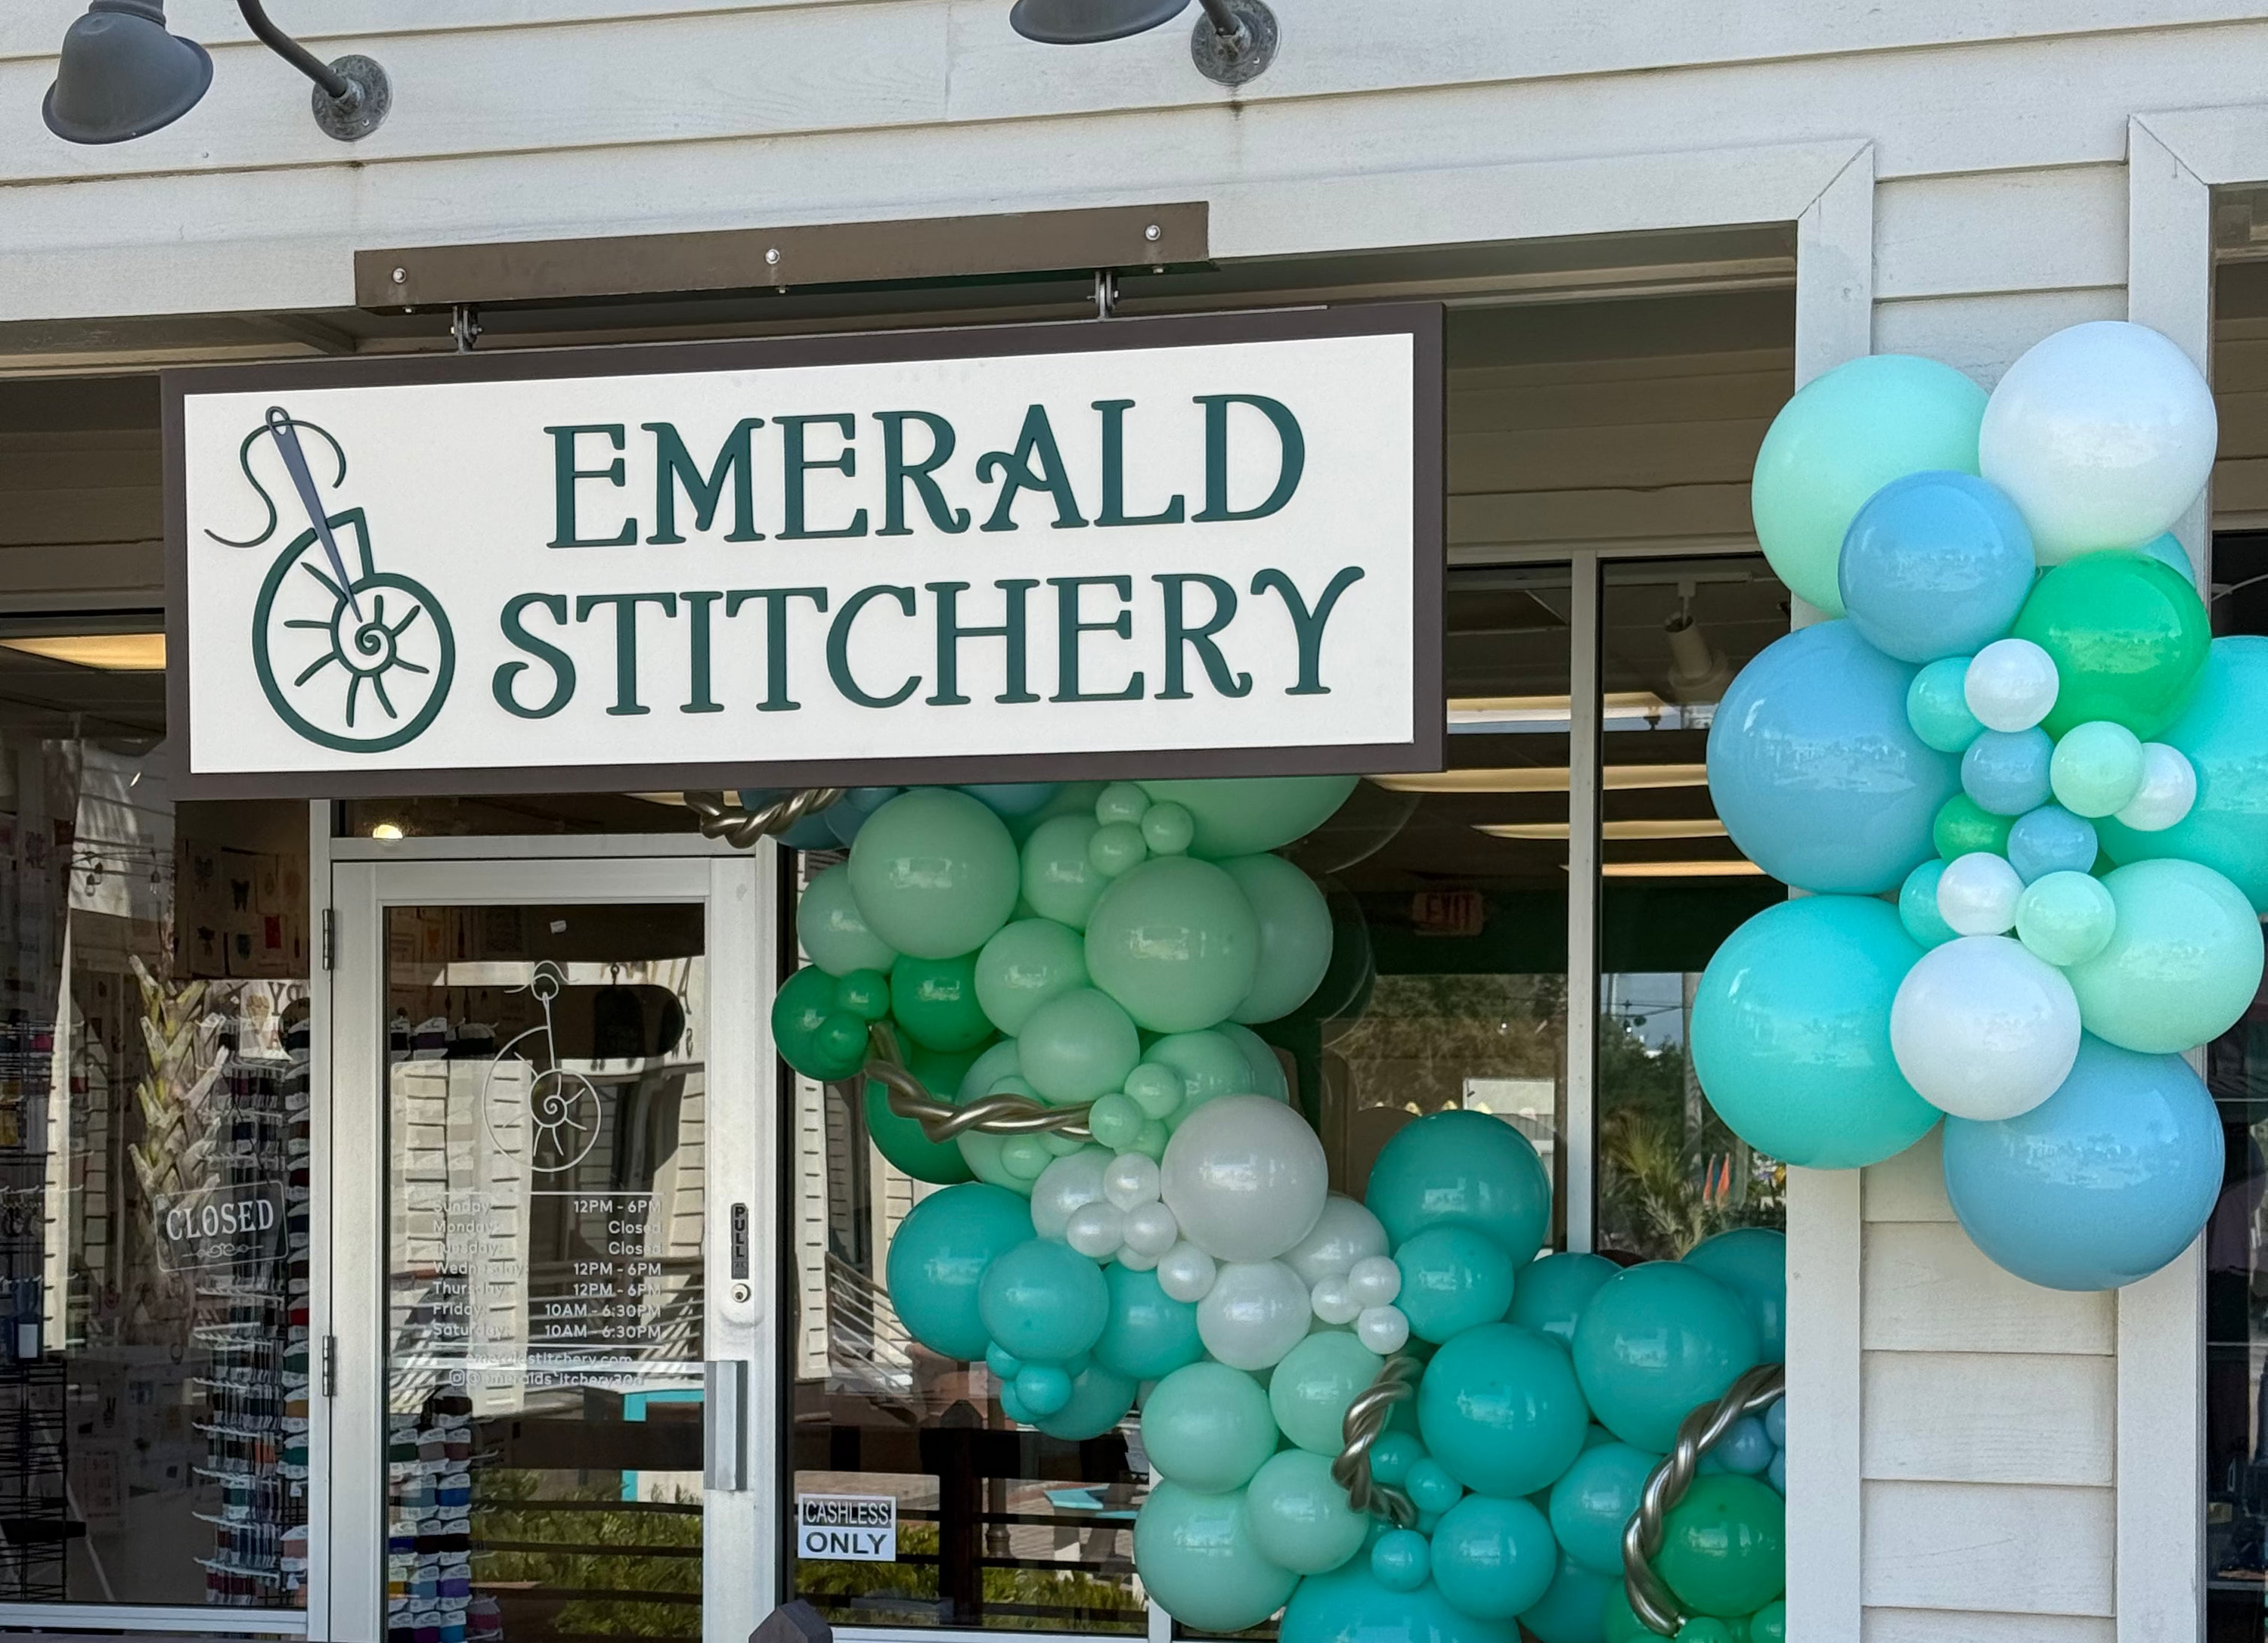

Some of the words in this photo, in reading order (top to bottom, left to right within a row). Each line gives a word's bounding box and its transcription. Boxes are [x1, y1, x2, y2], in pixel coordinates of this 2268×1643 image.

[544, 393, 1306, 549] EMERALD
[491, 566, 1365, 719] STITCHERY
[573, 1200, 613, 1214] 12PM
[627, 1200, 662, 1214] 6PM
[166, 1199, 274, 1241] CLOSED
[608, 1220, 662, 1235] Closed
[734, 1206, 745, 1257] PULL
[608, 1242, 662, 1255] Closed
[573, 1262, 613, 1276] 12PM
[627, 1262, 662, 1276] 6PM
[573, 1283, 613, 1297] 12PM
[627, 1283, 662, 1297] 6PM
[544, 1304, 588, 1317] 10AM
[602, 1304, 662, 1317] 6:30PM
[544, 1325, 588, 1338] 10AM
[602, 1325, 662, 1338] 6:30PM
[805, 1500, 889, 1525] CASHLESS
[805, 1531, 888, 1555] ONLY
